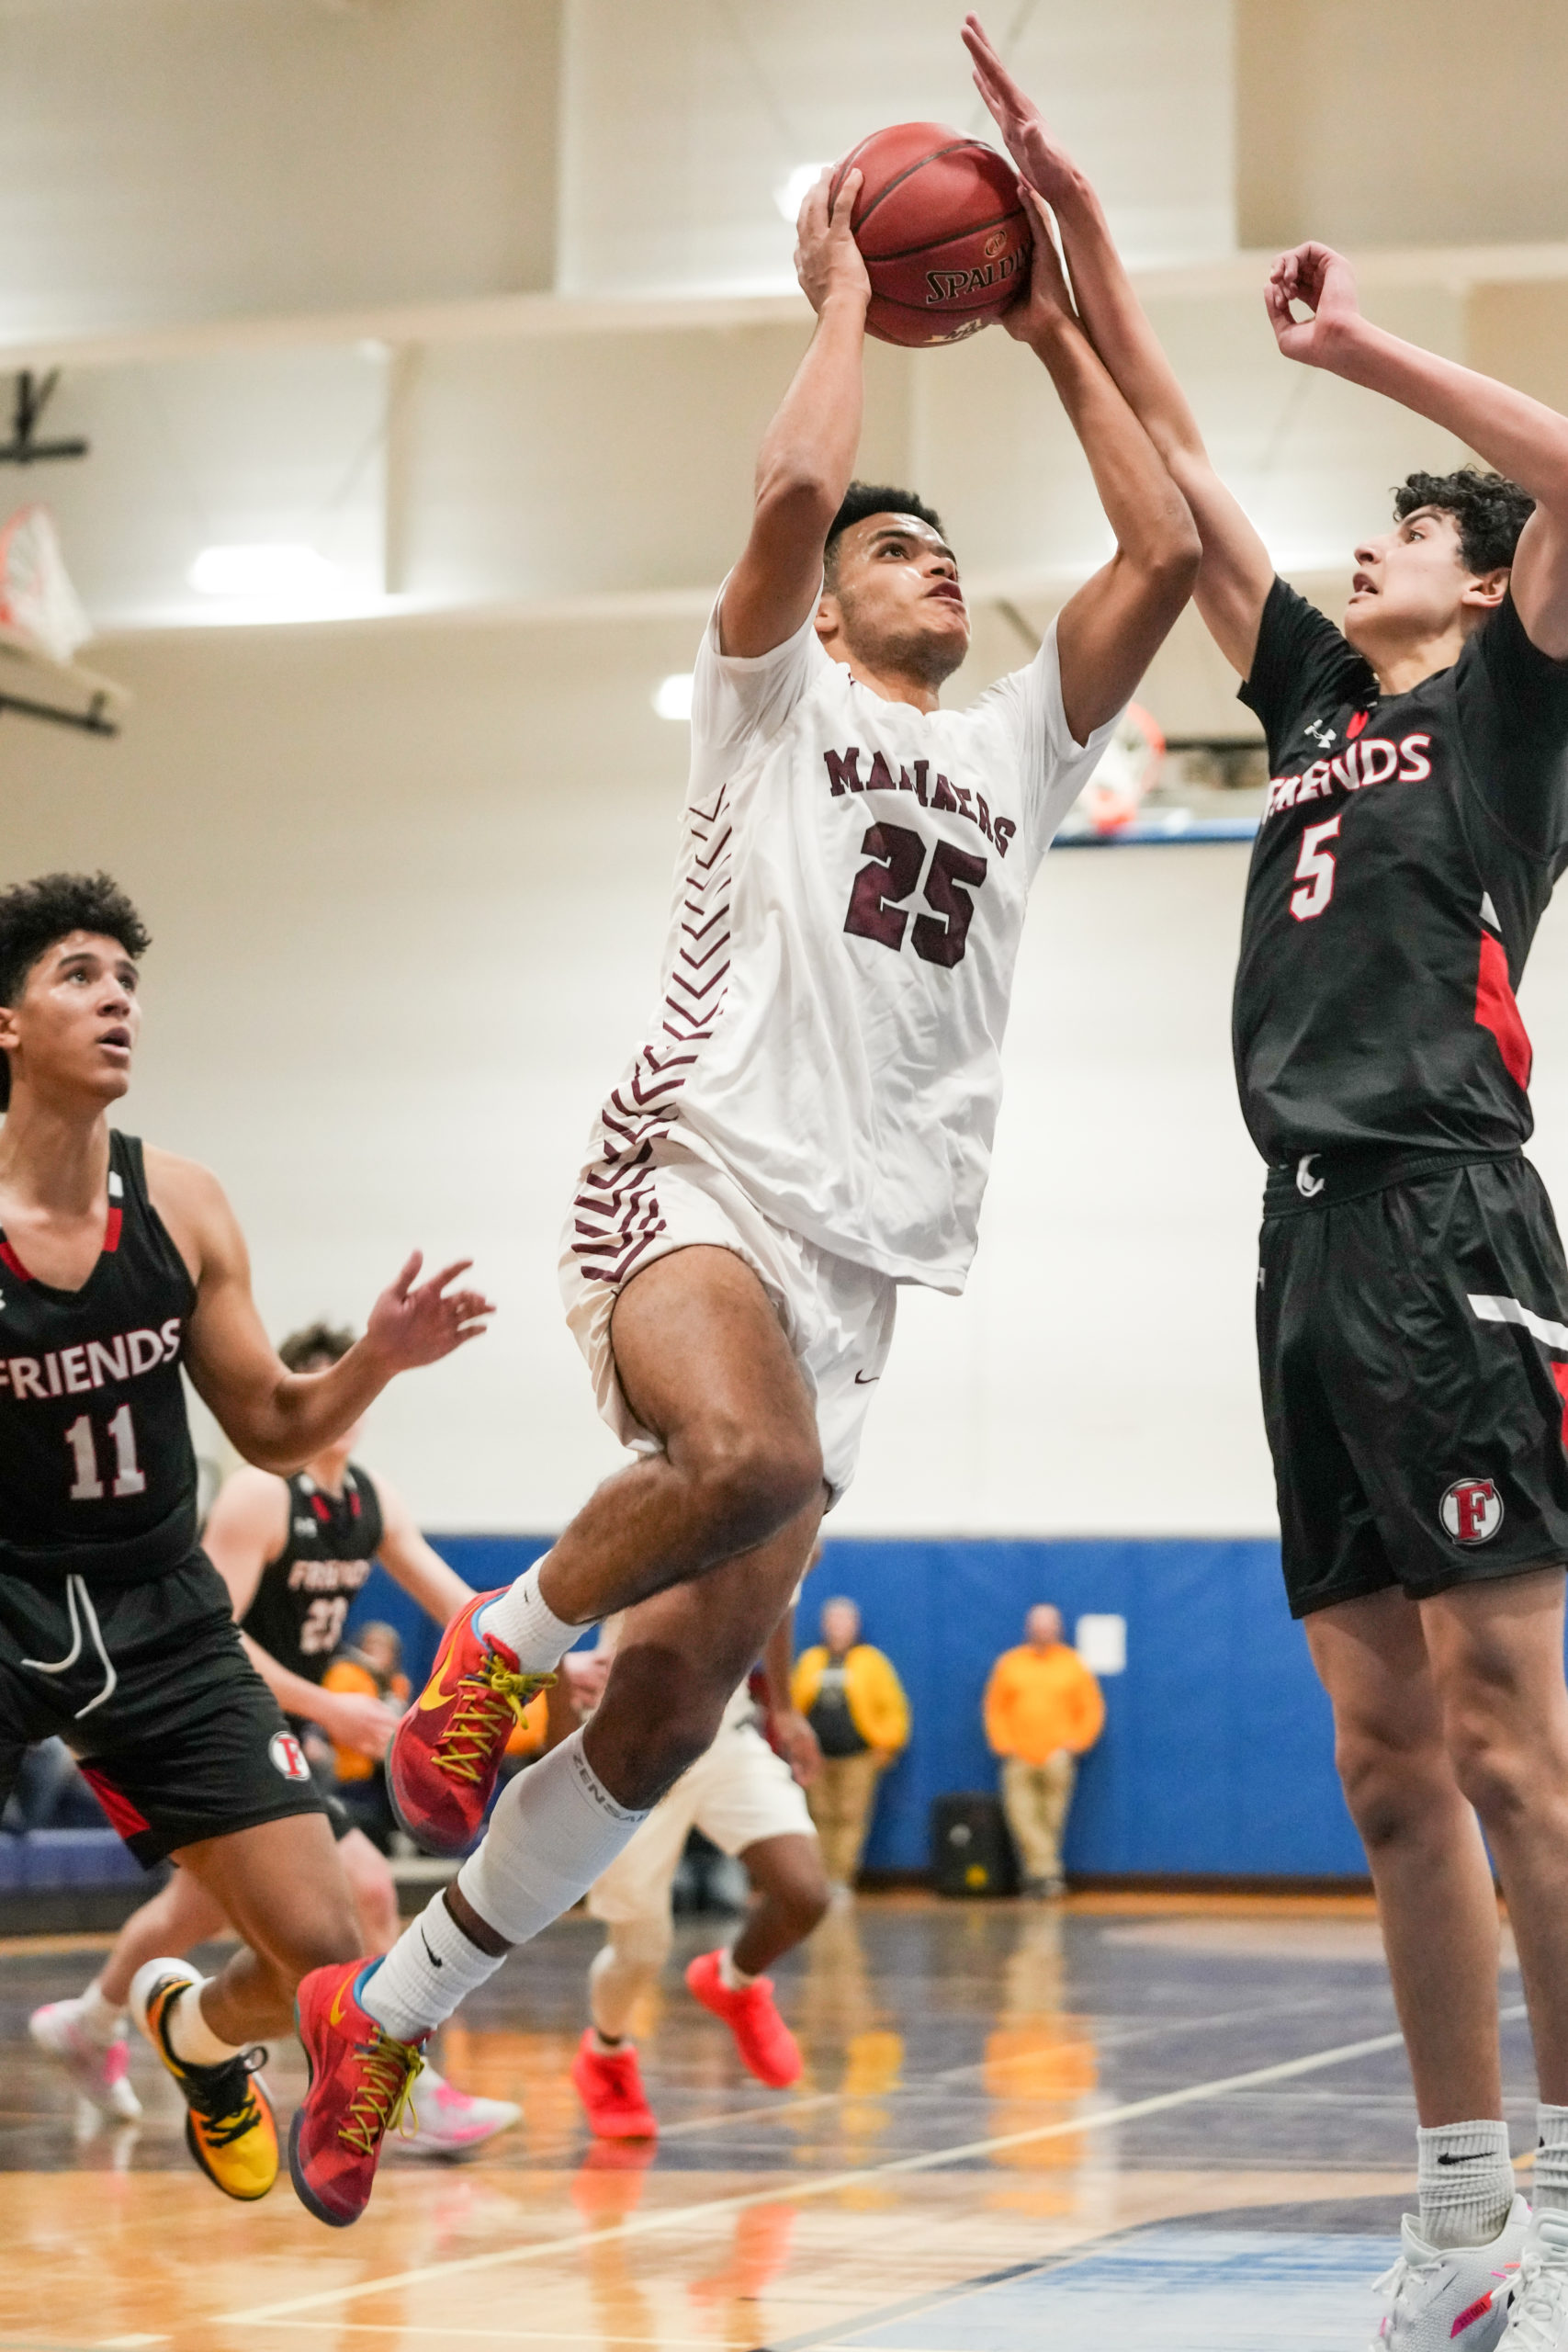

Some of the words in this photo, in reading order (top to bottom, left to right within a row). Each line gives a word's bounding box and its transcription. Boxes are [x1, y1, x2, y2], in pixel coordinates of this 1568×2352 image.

[1261, 731, 1432, 826] FRIENDS
[843, 820, 987, 970] 25
[1289, 814, 1342, 922] 5
[63, 1402, 146, 1500] 11
[1450, 1482, 1494, 1541] F
[277, 1737, 301, 1775] F
